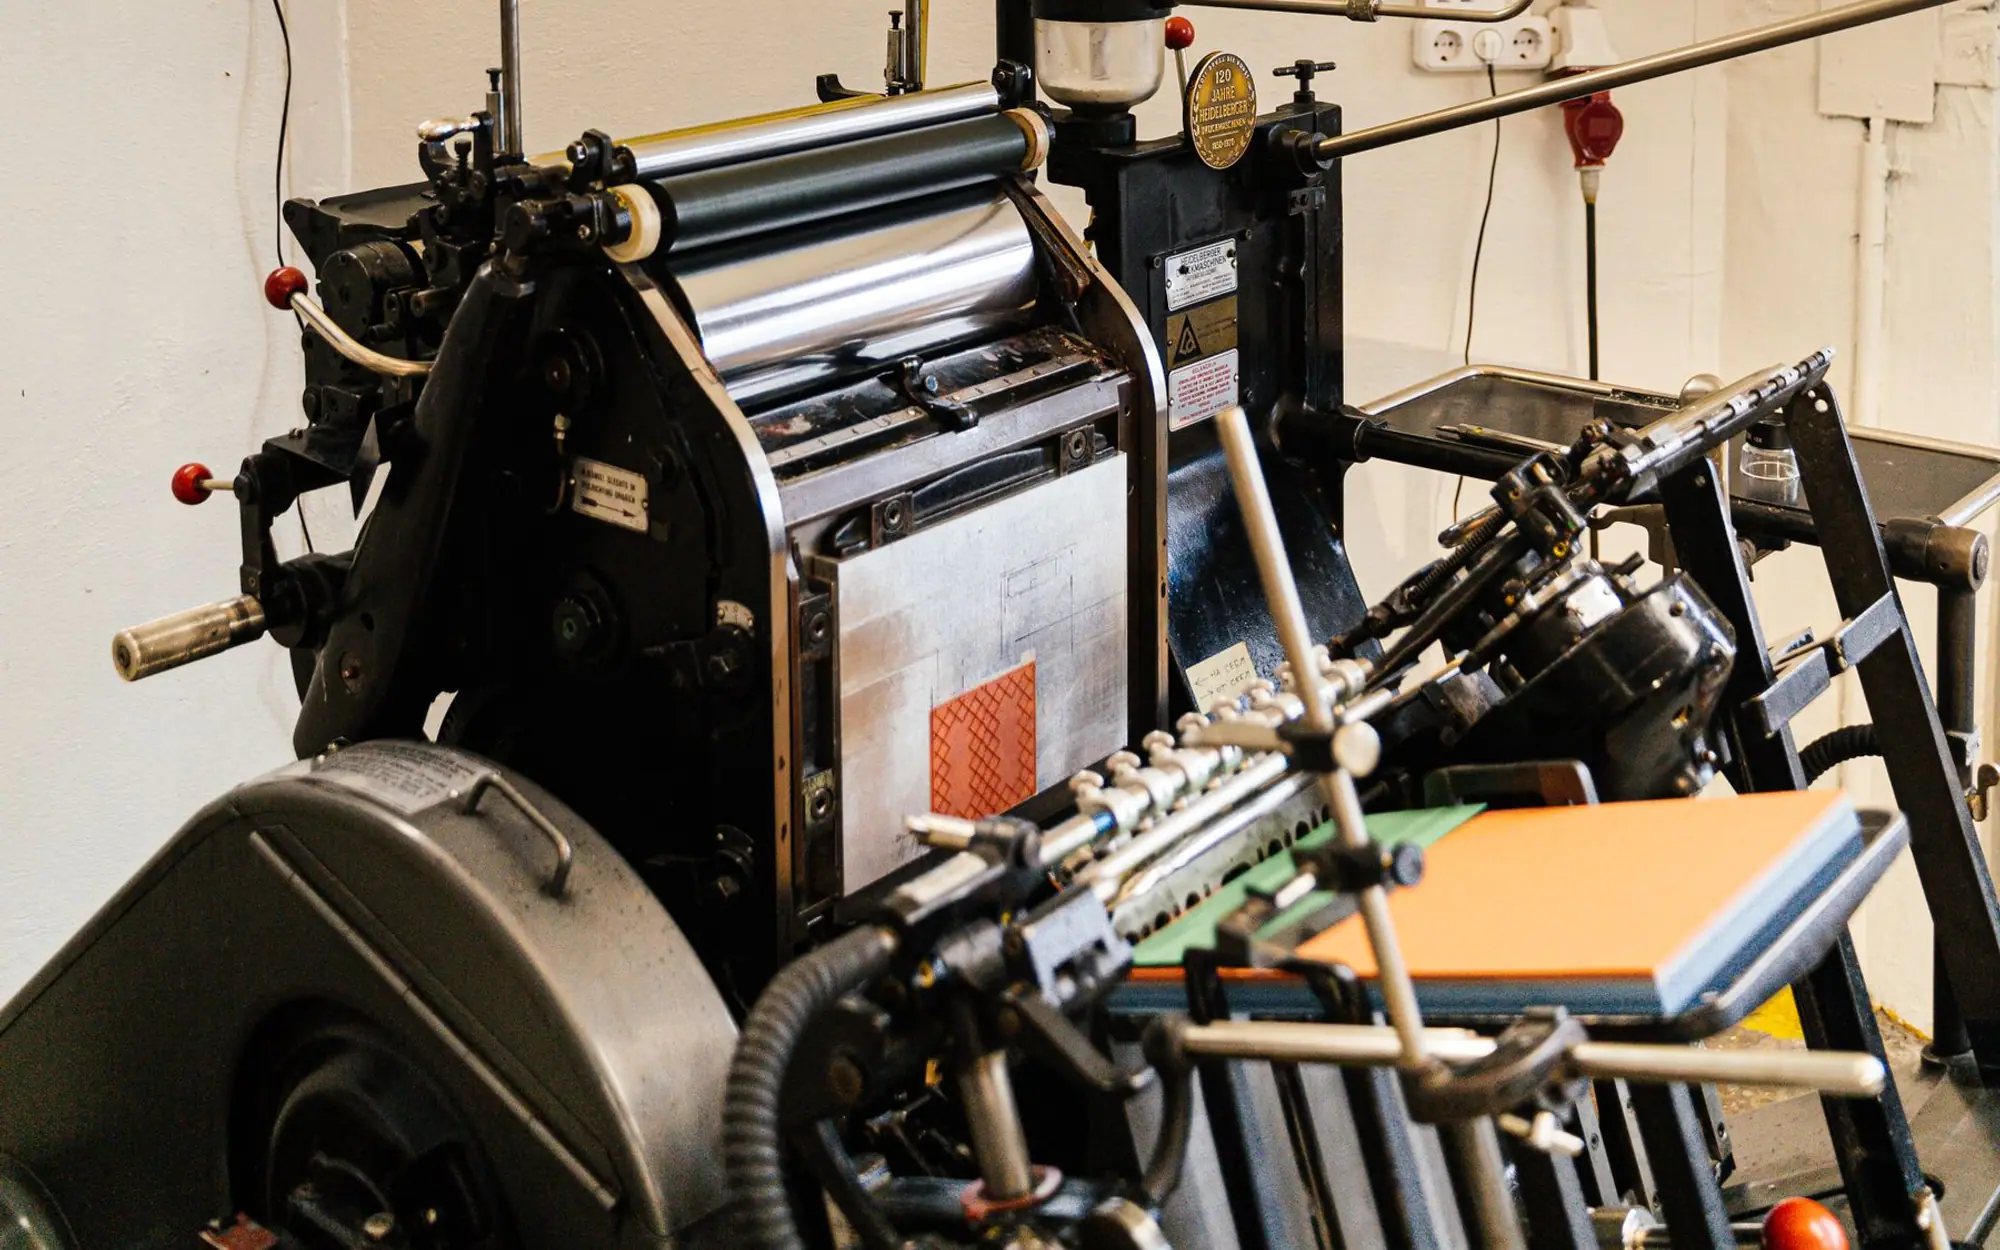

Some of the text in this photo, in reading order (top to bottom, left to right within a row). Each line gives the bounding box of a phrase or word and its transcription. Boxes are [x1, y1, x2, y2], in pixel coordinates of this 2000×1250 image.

[1215, 68, 1232, 84] 120
[1212, 85, 1236, 102] JAHRE
[1199, 99, 1248, 122] HEIDELBERGER
[1181, 246, 1222, 265] HEIDELBERGER
